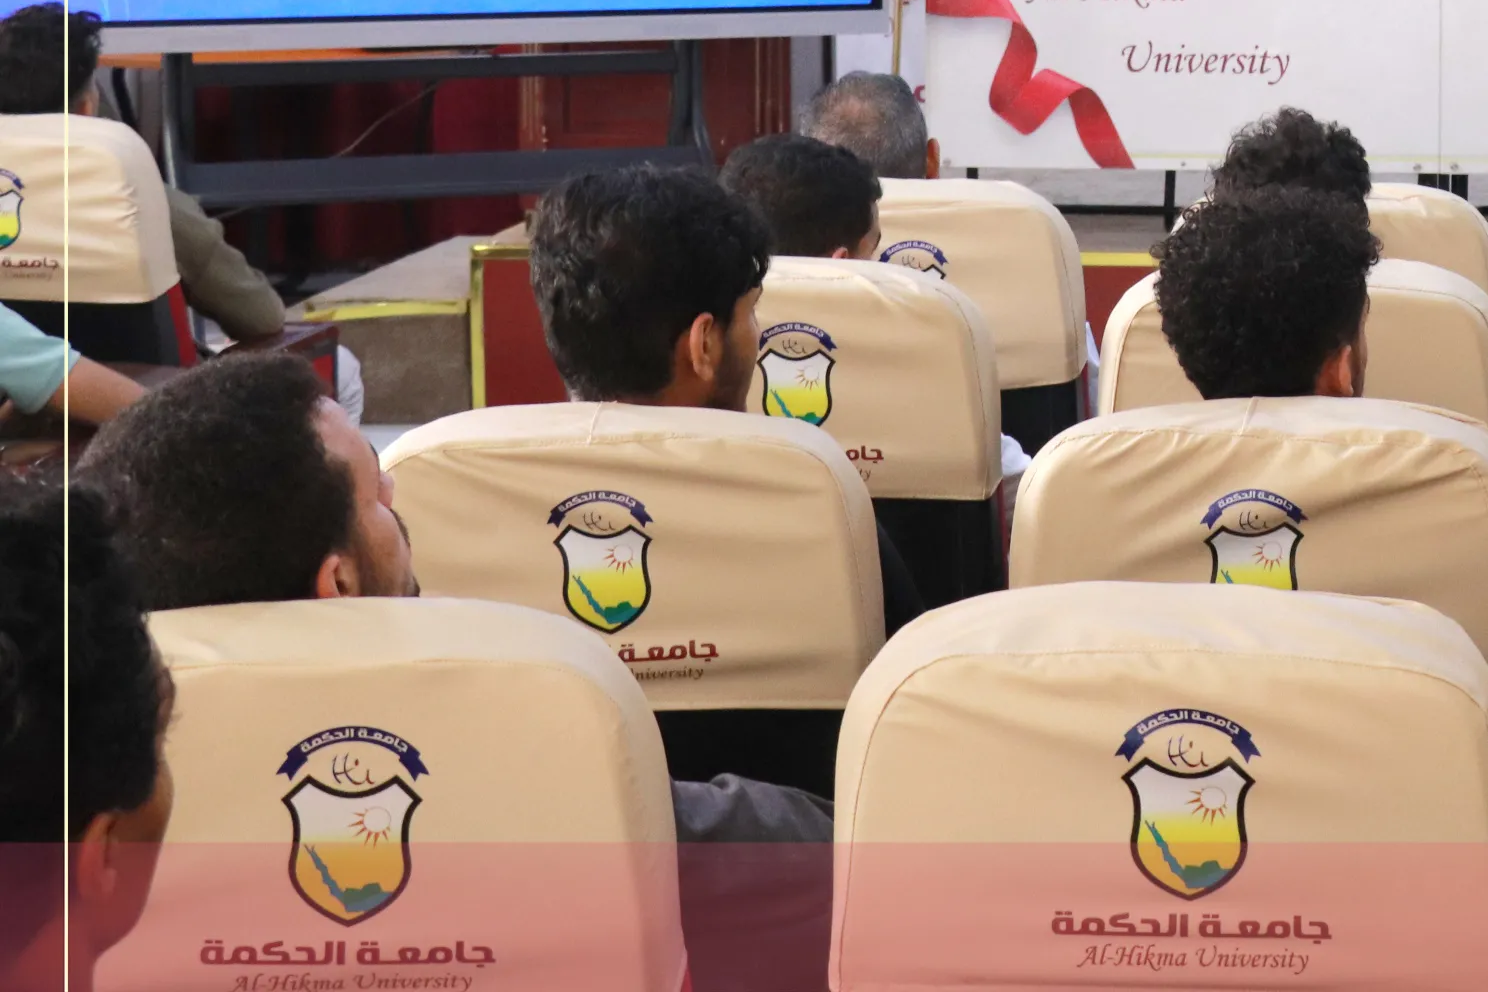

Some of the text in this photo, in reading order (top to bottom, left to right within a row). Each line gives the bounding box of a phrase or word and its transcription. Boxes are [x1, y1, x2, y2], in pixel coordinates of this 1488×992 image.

[1121, 41, 1290, 85] University
[845, 445, 884, 464] جام
[617, 638, 719, 664] جامعة
[1137, 710, 1240, 736] جامعة الحكمة
[301, 728, 408, 754] جامعة الحكمة
[1051, 911, 1332, 944] جامعة الحكمة
[200, 939, 496, 968] جامعة الحكمة
[1077, 943, 1310, 976] Al-Hikma University
[231, 972, 473, 992] Al-Hikma University
